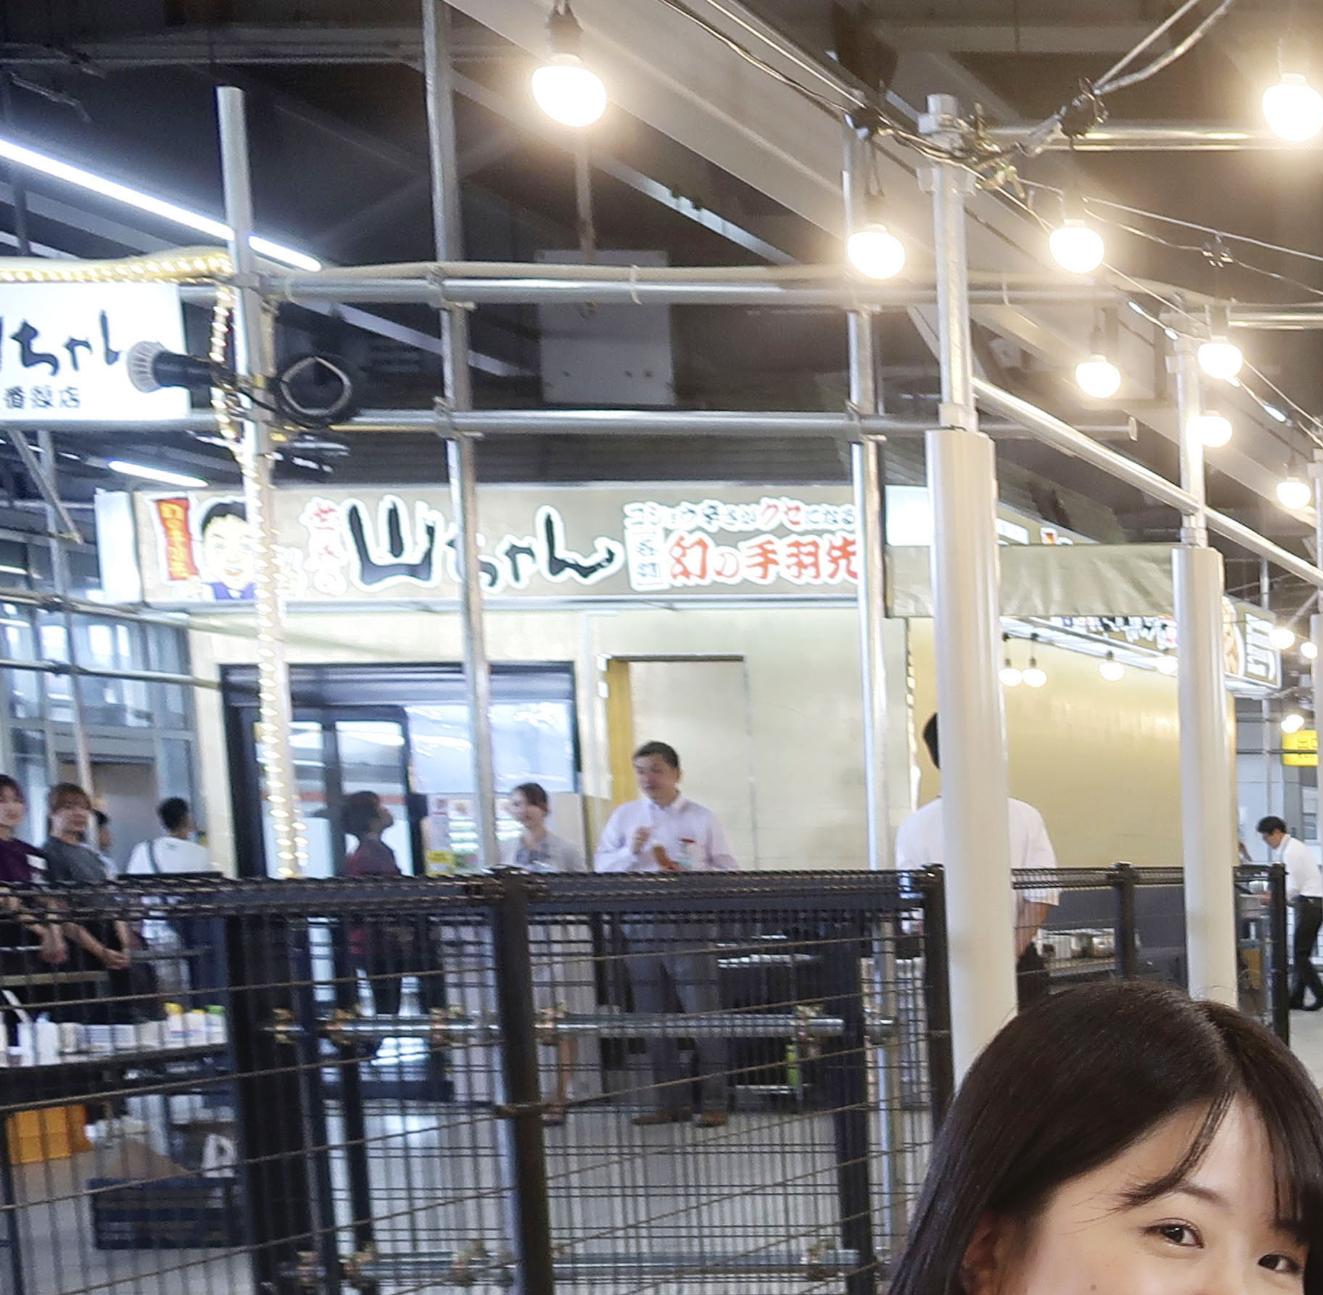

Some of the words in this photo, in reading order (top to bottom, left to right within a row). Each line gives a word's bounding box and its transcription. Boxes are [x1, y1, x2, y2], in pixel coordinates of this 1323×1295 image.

[669, 535, 858, 579] 幻の手羽先
